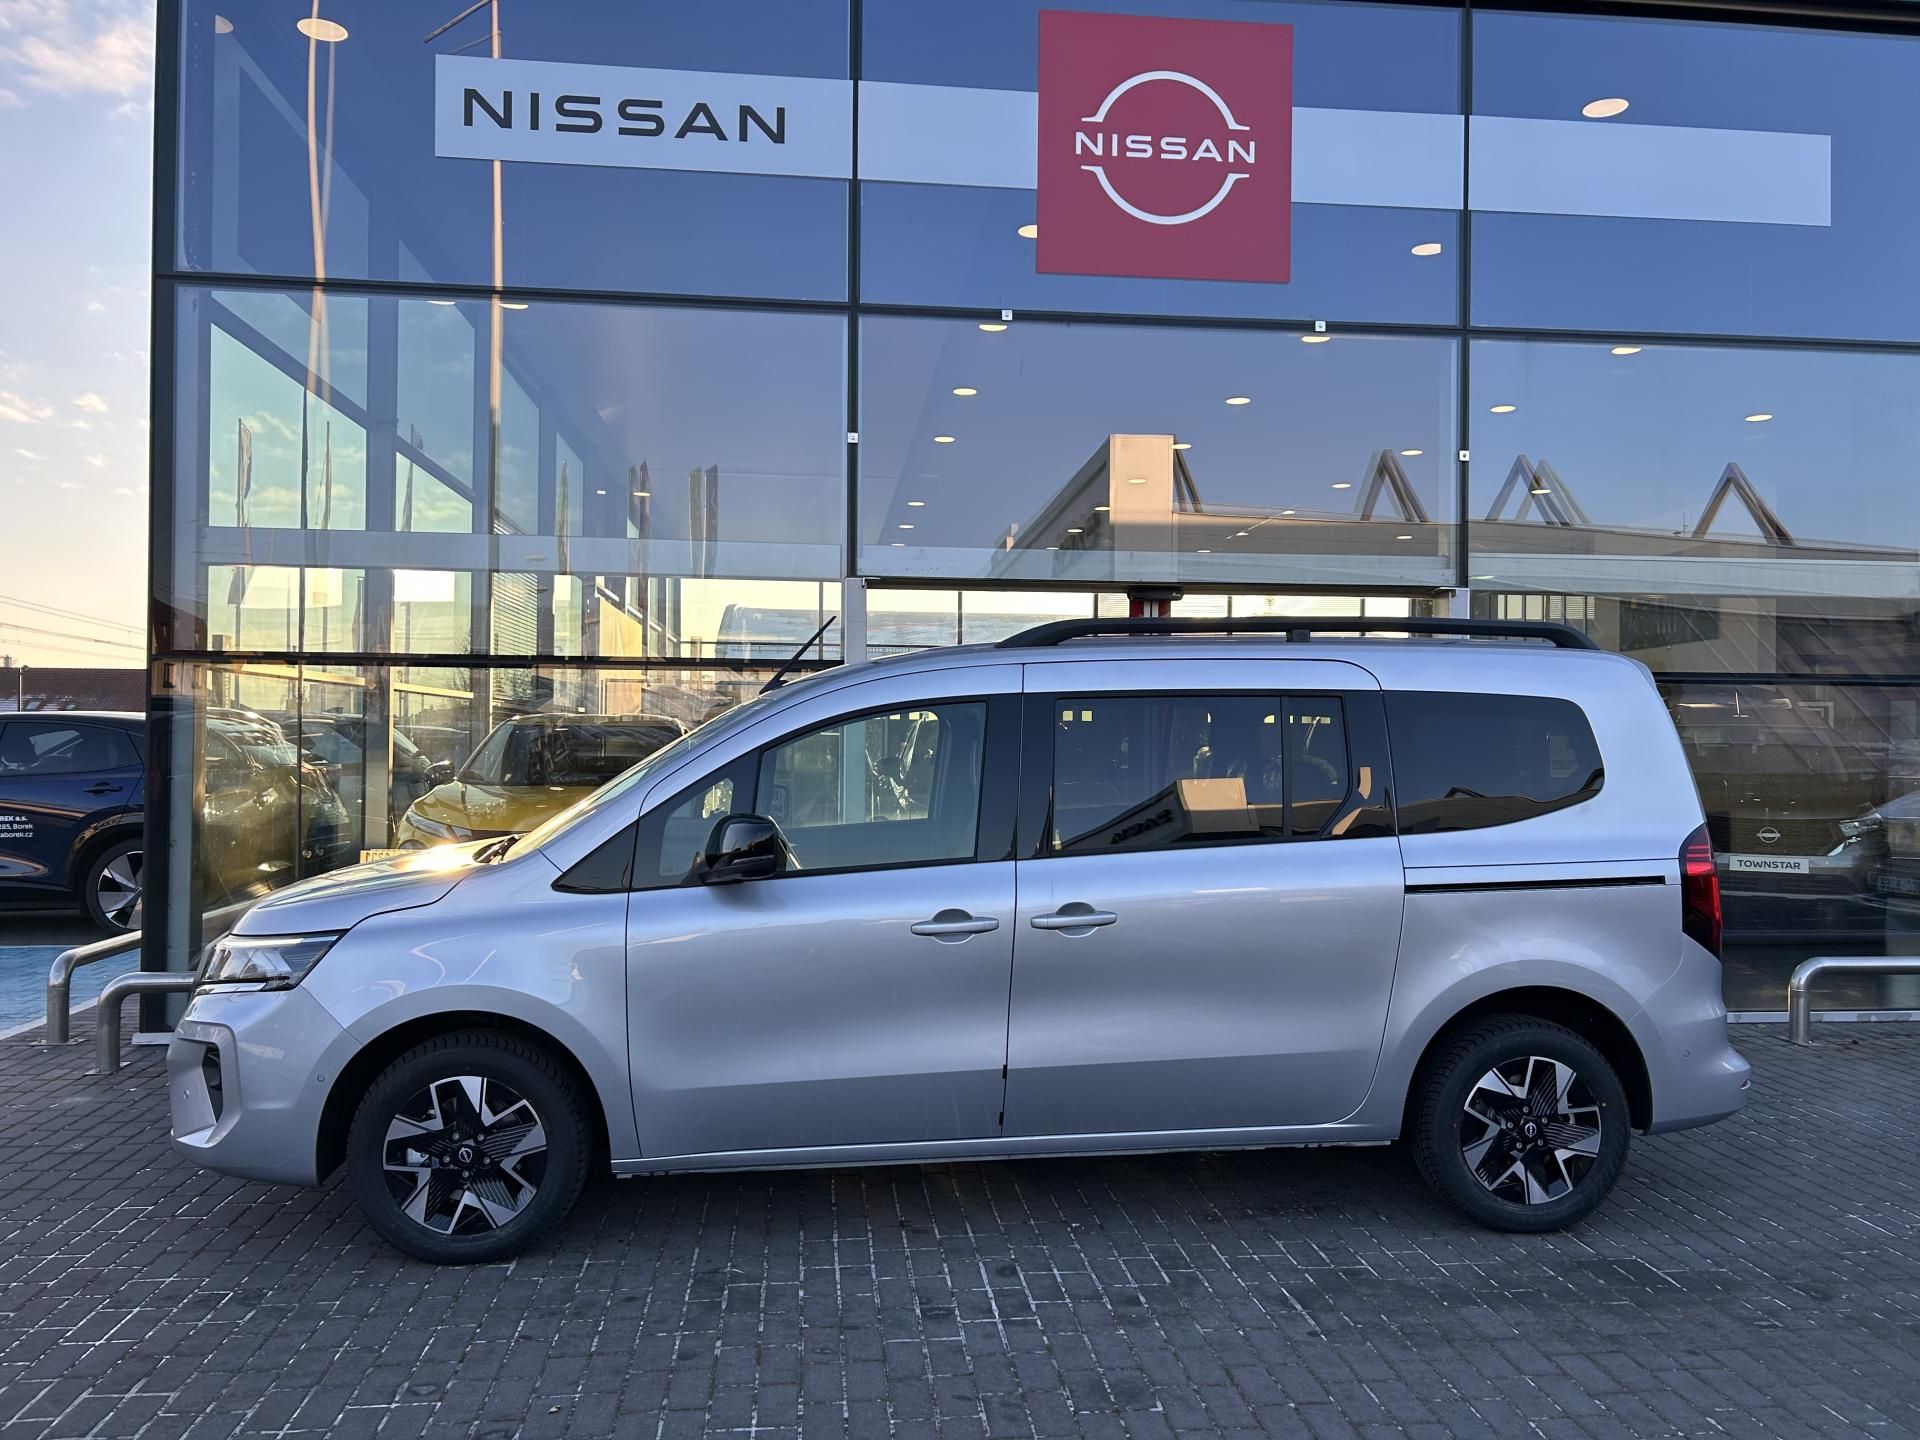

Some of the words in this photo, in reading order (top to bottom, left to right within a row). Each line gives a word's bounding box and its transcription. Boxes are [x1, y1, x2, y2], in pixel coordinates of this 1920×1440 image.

[463, 87, 786, 145] NISSAN
[1075, 131, 1256, 164] NISSAN
[1737, 859, 1801, 870] TOWNSTAR
